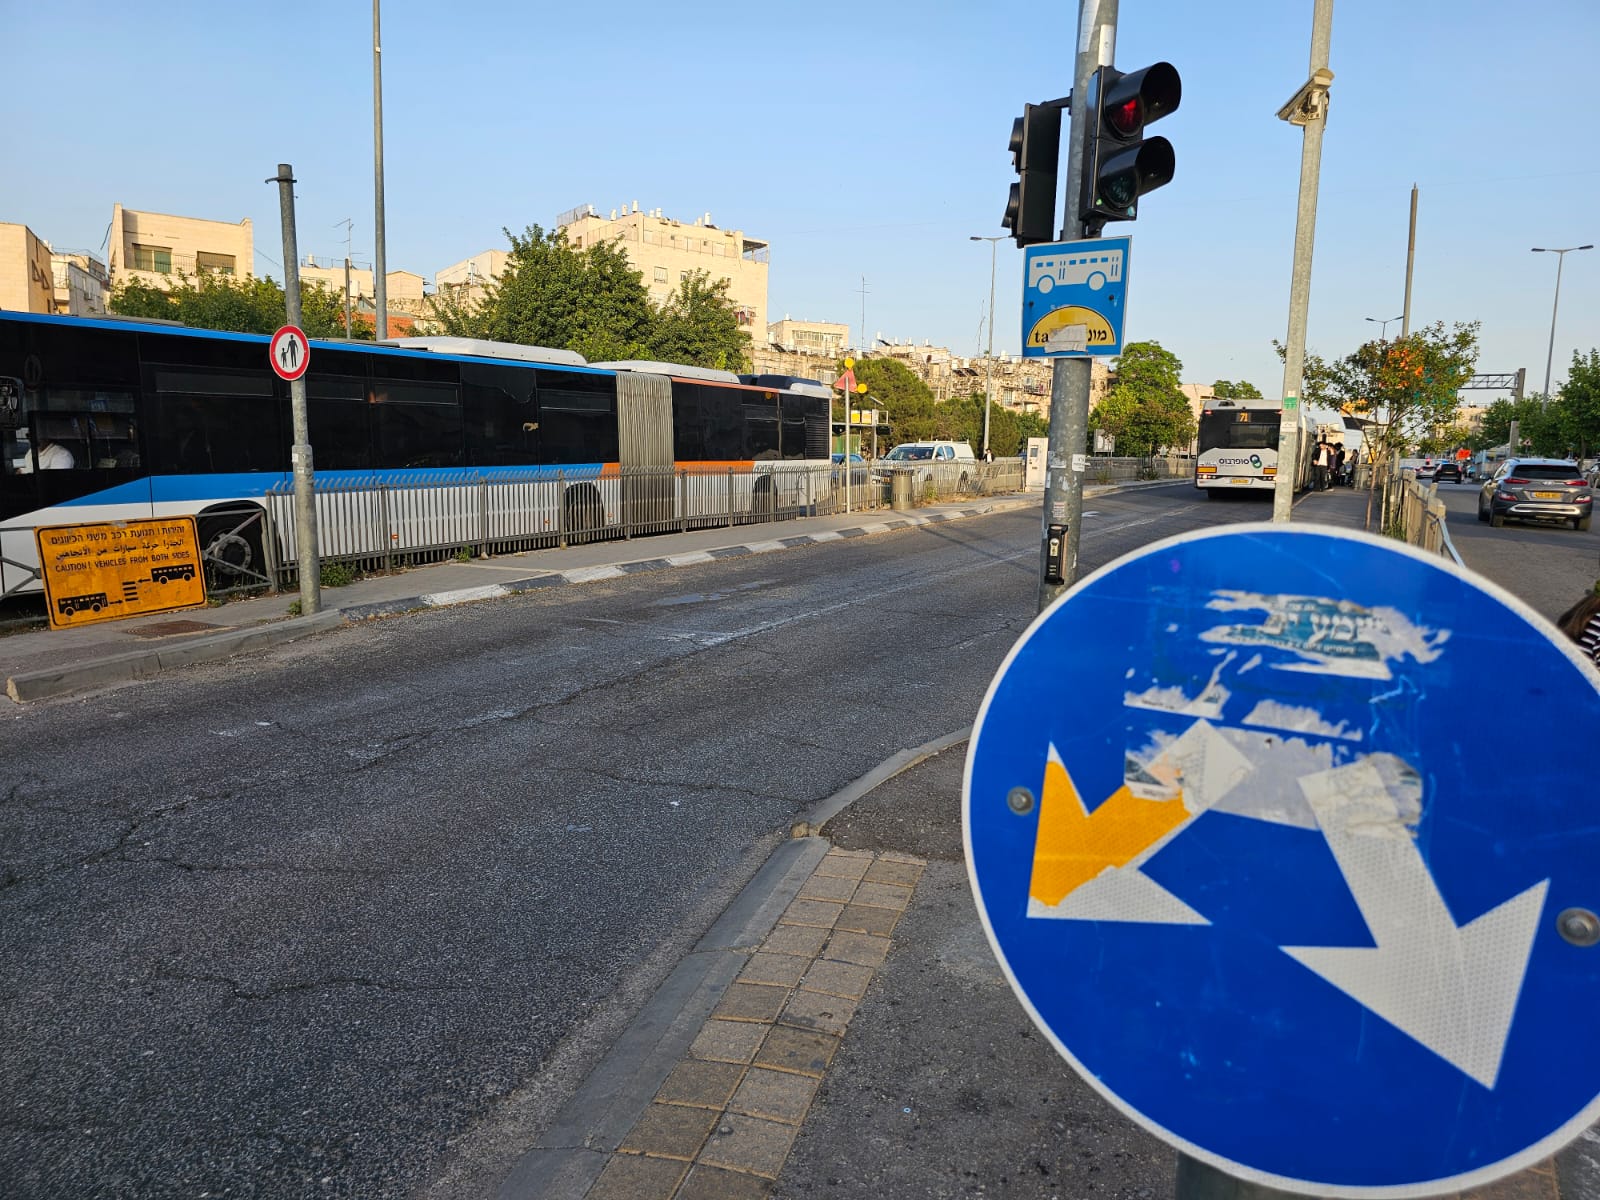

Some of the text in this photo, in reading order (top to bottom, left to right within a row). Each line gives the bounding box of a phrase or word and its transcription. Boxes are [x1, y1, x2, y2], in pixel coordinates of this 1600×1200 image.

[1034, 331, 1049, 343] ta
[1087, 329, 1107, 341] מונ
[1239, 412, 1249, 422] 71
[86, 532, 107, 541] משני
[111, 531, 127, 539] רכב
[130, 528, 155, 538] תנועת
[95, 557, 127, 568] VEHICLES
[129, 555, 149, 565] FROM
[151, 553, 169, 562] BOTH
[172, 550, 190, 559] SIDES
